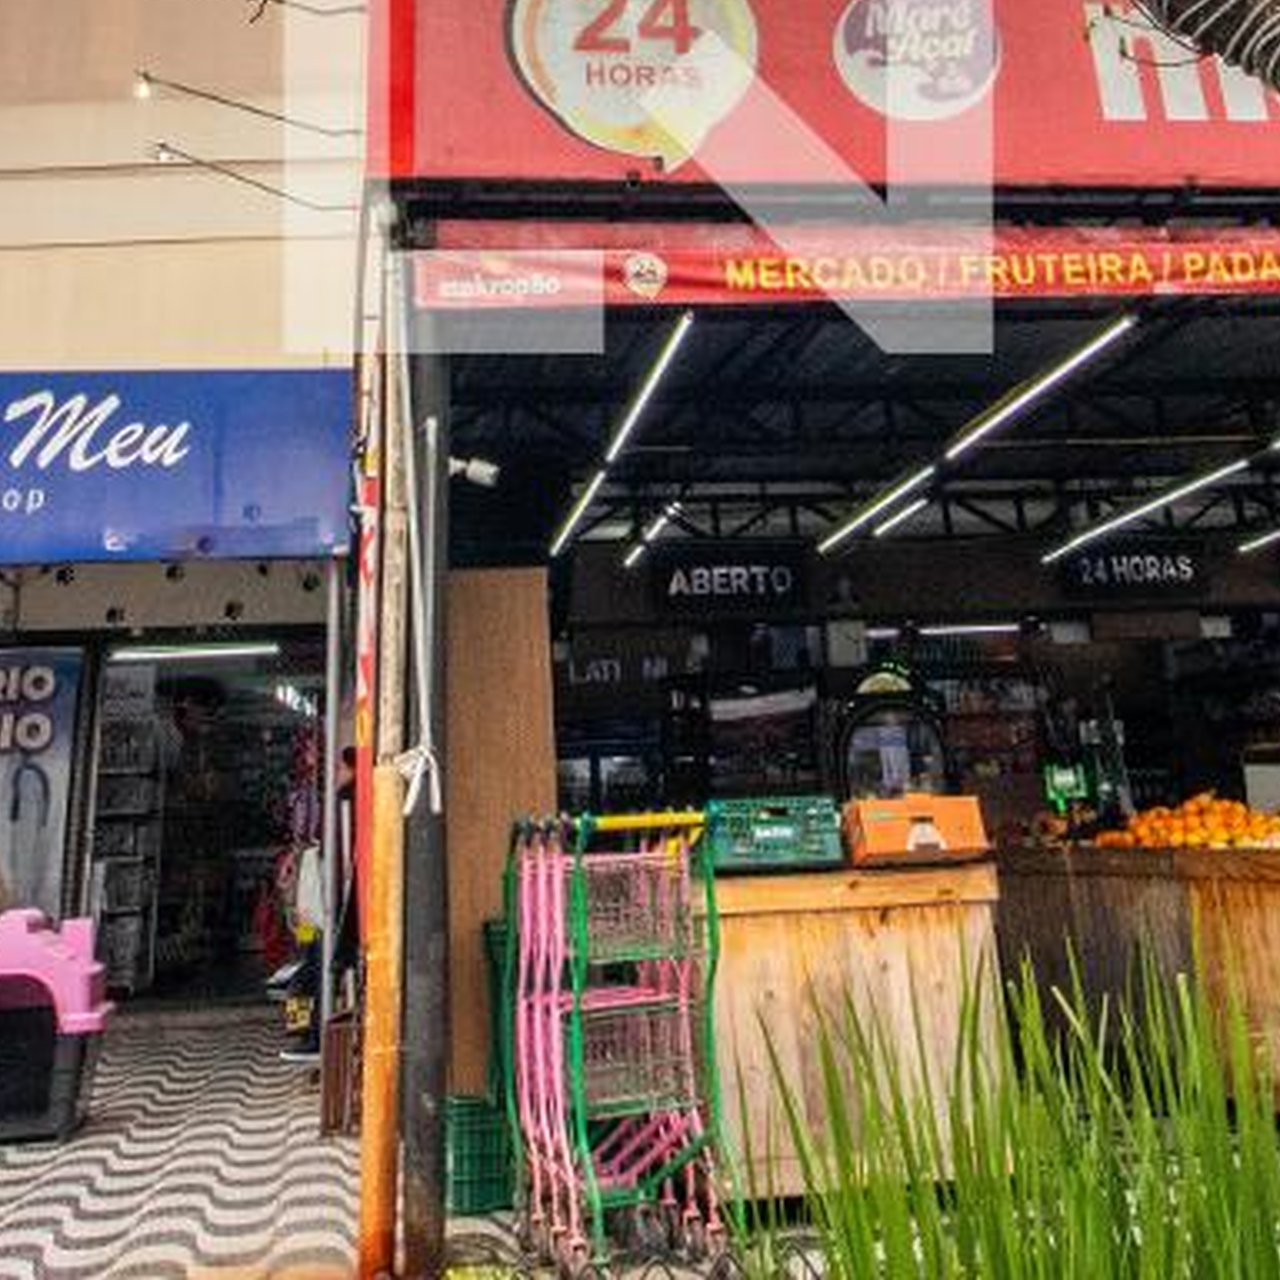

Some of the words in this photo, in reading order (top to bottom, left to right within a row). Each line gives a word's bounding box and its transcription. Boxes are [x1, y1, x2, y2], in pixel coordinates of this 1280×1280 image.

[585, 62, 697, 87] HORAS
[724, 256, 926, 290] MERCADO
[959, 252, 1154, 286] FRUTEIRA
[4, 389, 192, 473] Meu
[668, 565, 793, 596] ABERTO
[1081, 557, 1108, 583] 24
[1110, 555, 1195, 584] HORAS
